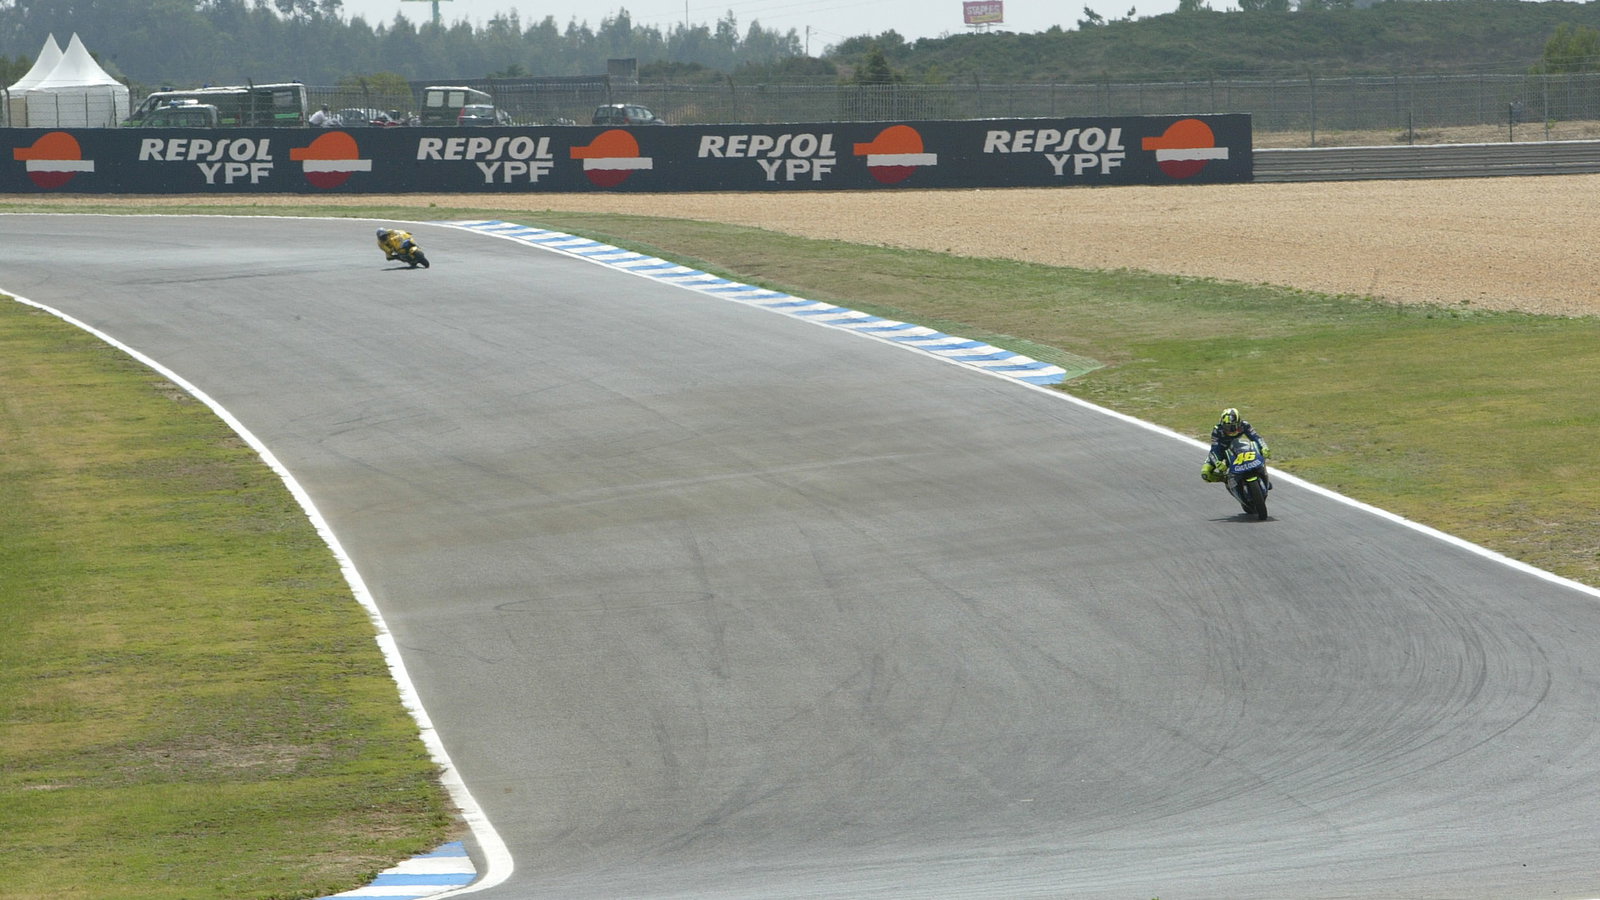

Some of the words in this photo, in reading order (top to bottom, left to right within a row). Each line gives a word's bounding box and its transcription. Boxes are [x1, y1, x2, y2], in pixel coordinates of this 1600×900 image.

[138, 138, 273, 162] REPSOL
[416, 136, 553, 161] REPSOL
[697, 133, 836, 158] REPSOL
[983, 127, 1125, 154] REPSOL
[196, 162, 274, 185] YPF
[476, 160, 554, 184] YPF
[756, 158, 837, 182] YPF
[1044, 151, 1126, 176] YPF
[1233, 451, 1256, 465] 46
